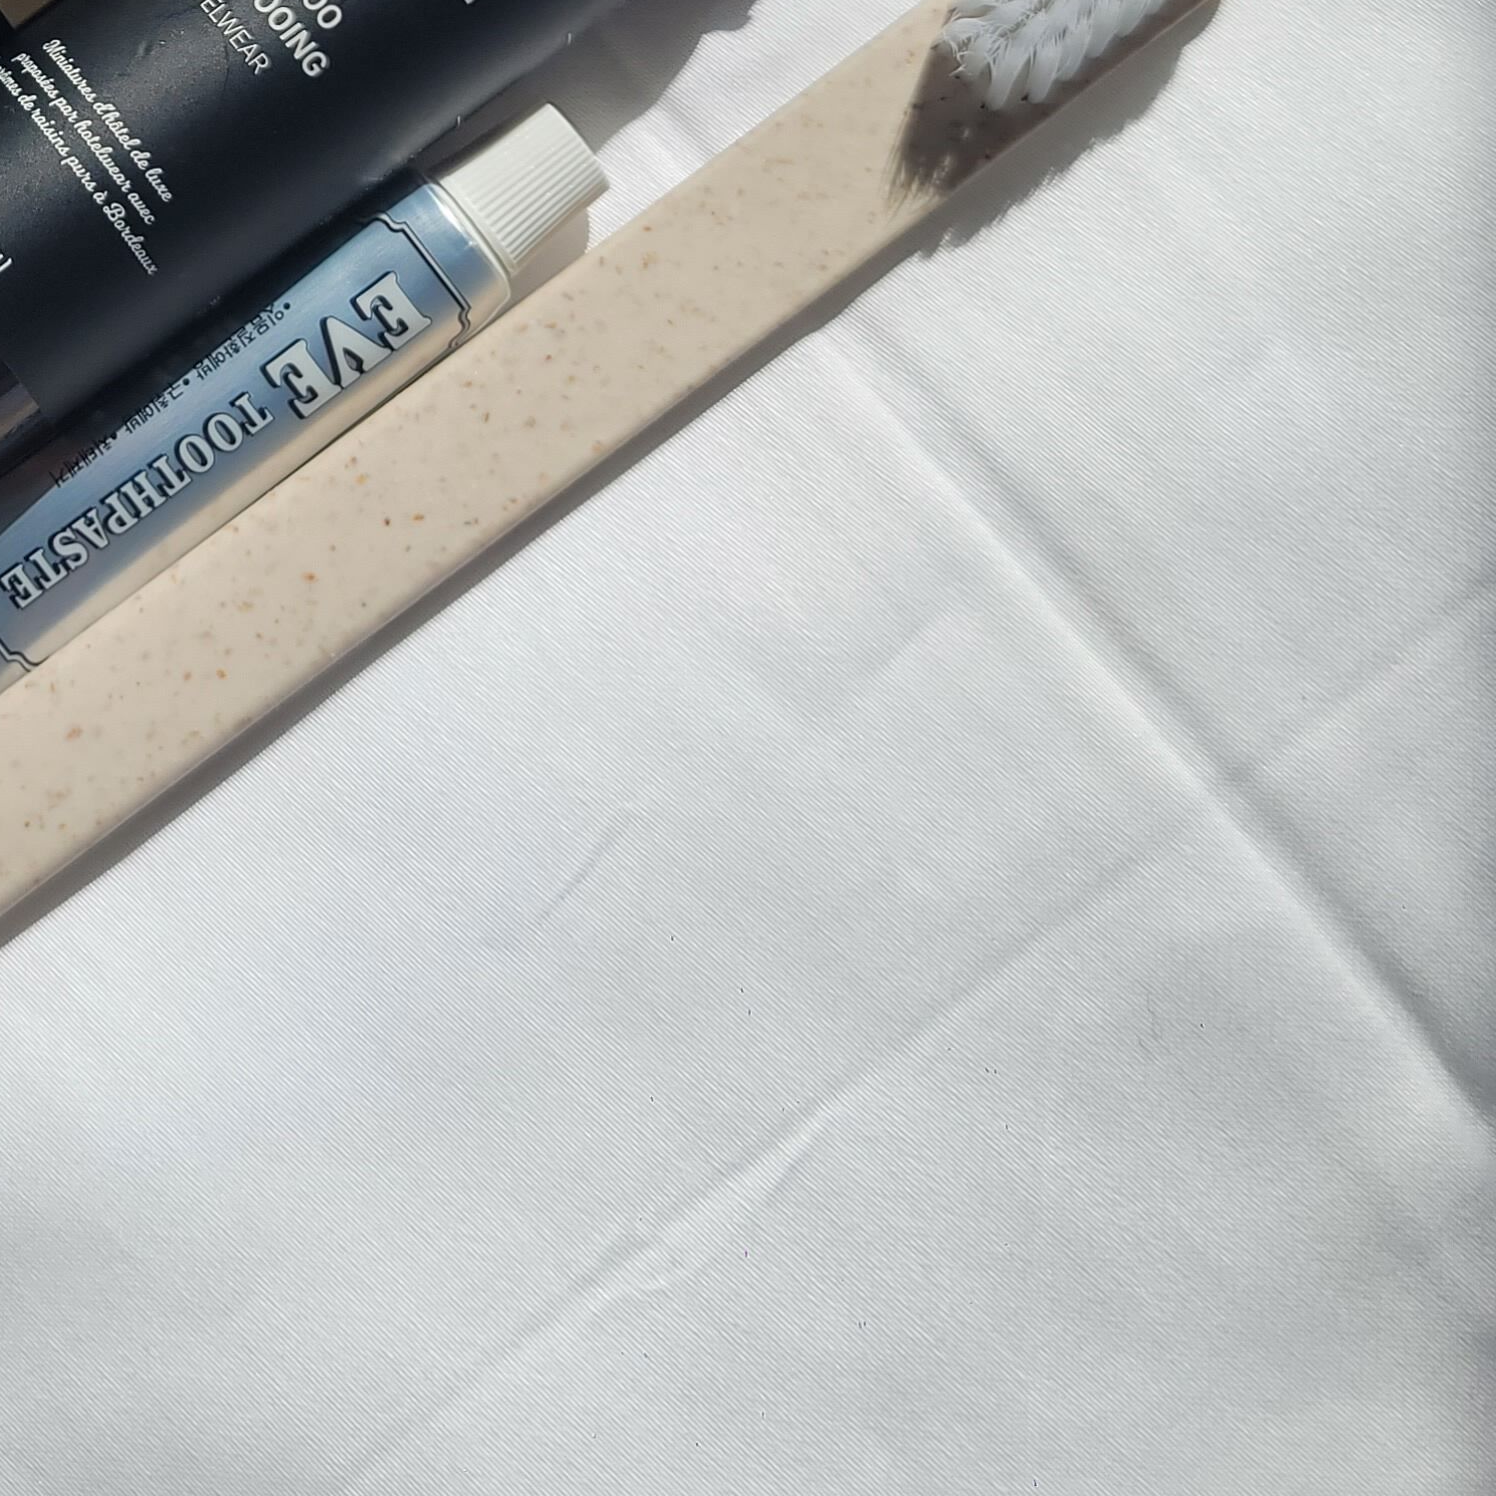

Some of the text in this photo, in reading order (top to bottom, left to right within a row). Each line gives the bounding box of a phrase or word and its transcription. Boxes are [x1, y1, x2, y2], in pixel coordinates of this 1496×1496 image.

[10, 52, 156, 226] proposées par hotelwear avec
[17, 94, 37, 111] de
[30, 107, 71, 158] raisins
[60, 155, 96, 192] purs
[92, 190, 108, 205] à
[103, 202, 158, 276] Bordeaux
[42, 39, 97, 103] Miniatures
[130, 149, 151, 170] de
[145, 167, 173, 203] luxe
[259, 270, 432, 419] EVE
